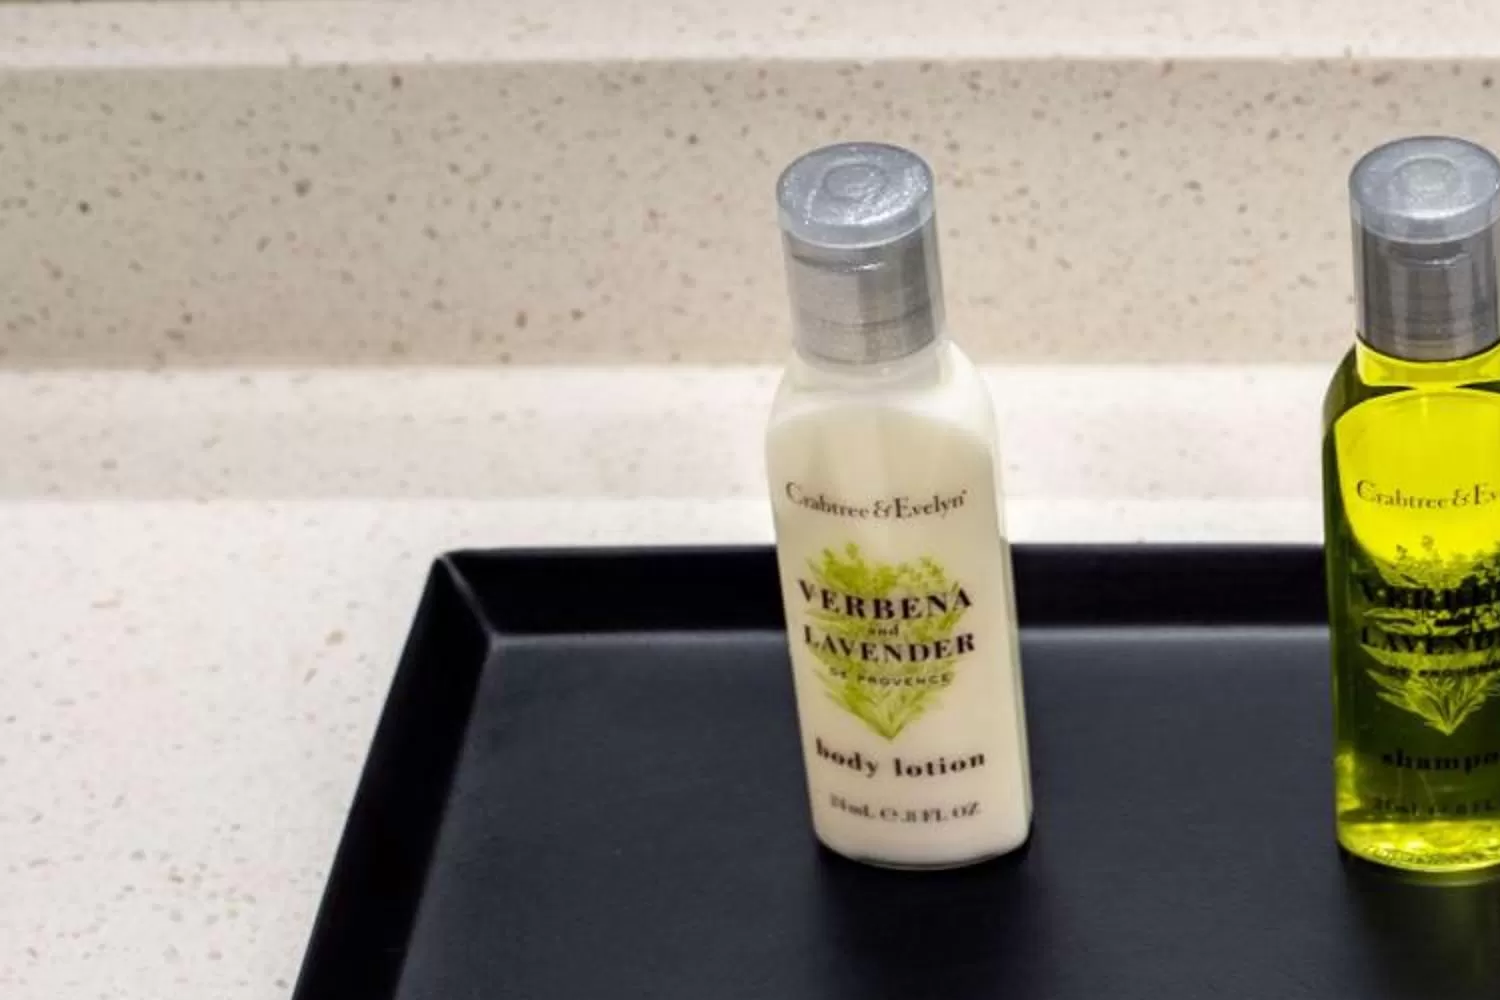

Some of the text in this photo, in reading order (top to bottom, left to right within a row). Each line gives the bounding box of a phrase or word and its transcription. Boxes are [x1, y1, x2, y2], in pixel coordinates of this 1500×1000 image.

[785, 481, 870, 519] Crabtree
[893, 493, 966, 520] Evelyn
[1356, 478, 1447, 509] Crabtree
[797, 578, 973, 621] VERBENA
[803, 624, 976, 663] LAVENDER
[866, 623, 899, 638] and
[857, 671, 952, 687] PROVENCE
[815, 736, 986, 779] body lotion
